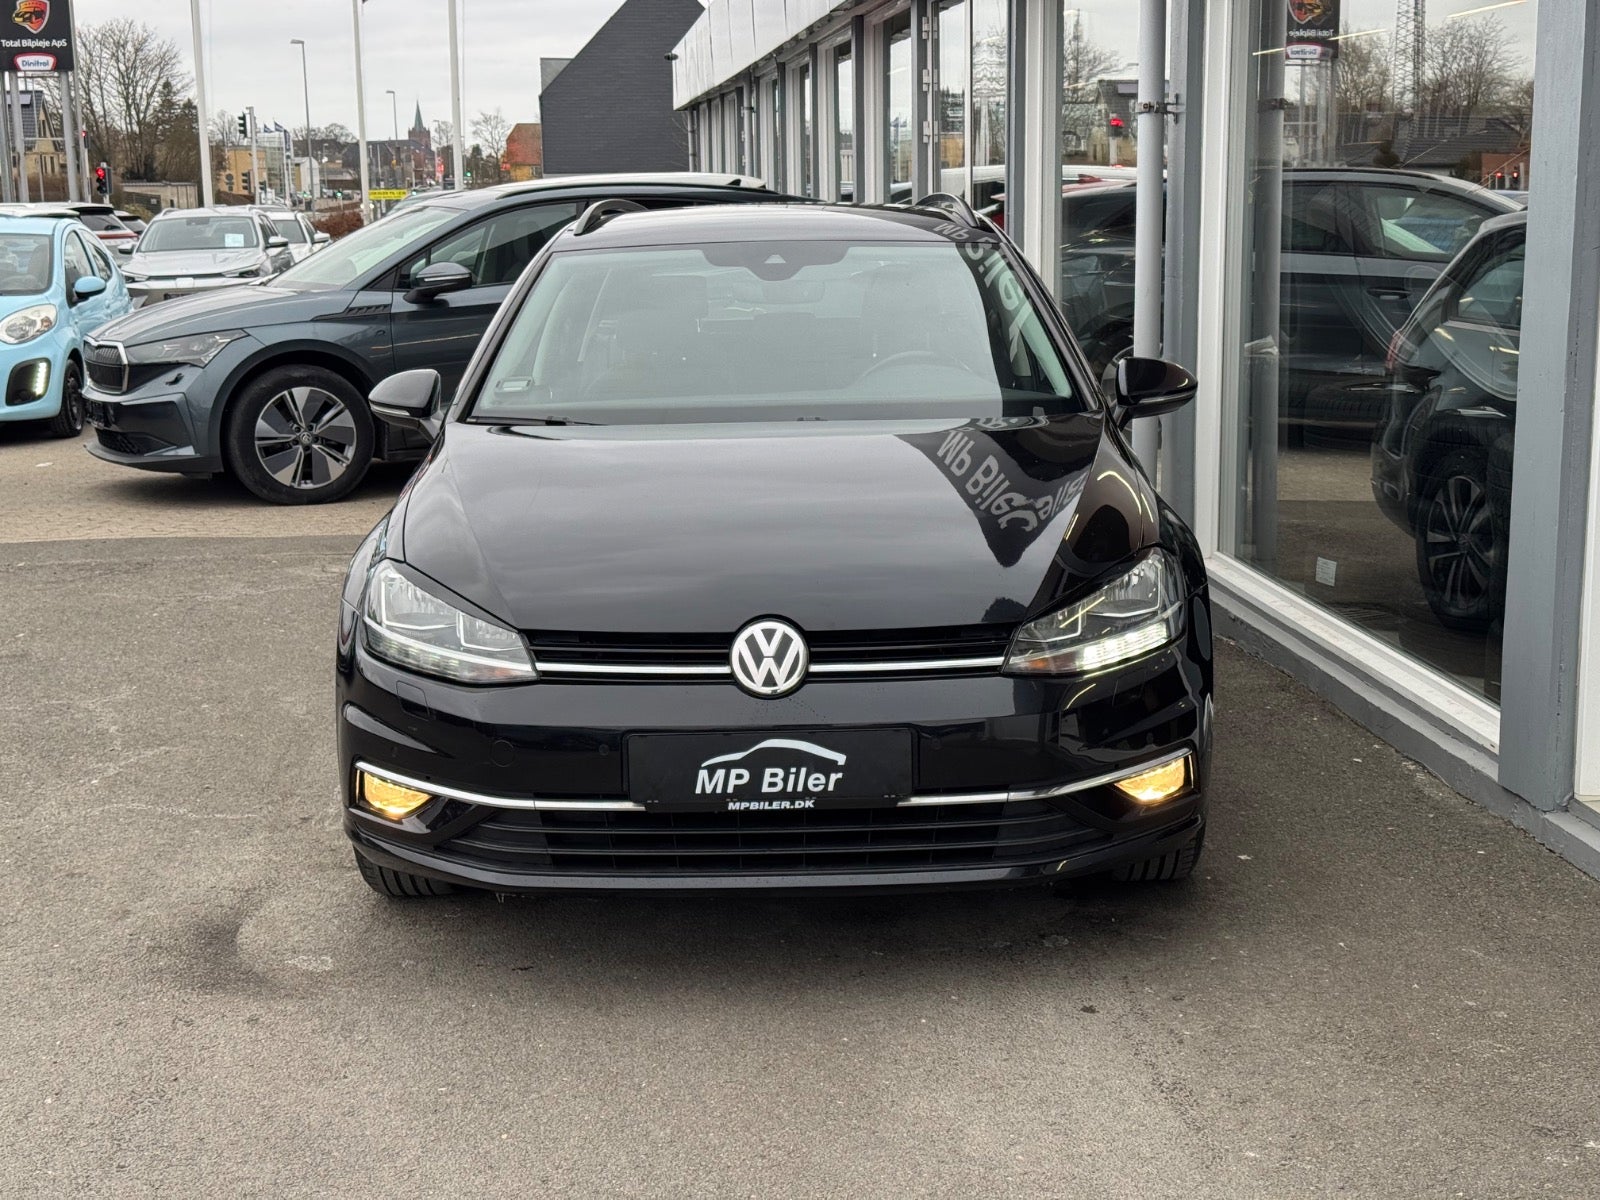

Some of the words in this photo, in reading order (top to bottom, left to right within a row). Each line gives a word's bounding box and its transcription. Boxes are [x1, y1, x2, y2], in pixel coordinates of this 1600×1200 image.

[1, 39, 21, 48] Total
[22, 38, 50, 49] Bilpleje
[51, 39, 68, 48] ApS
[21, 59, 50, 67] Dinitrol
[733, 623, 806, 693] VW
[694, 768, 751, 795] MP
[760, 766, 844, 793] Biler
[727, 799, 816, 811] MPBILER.DK
